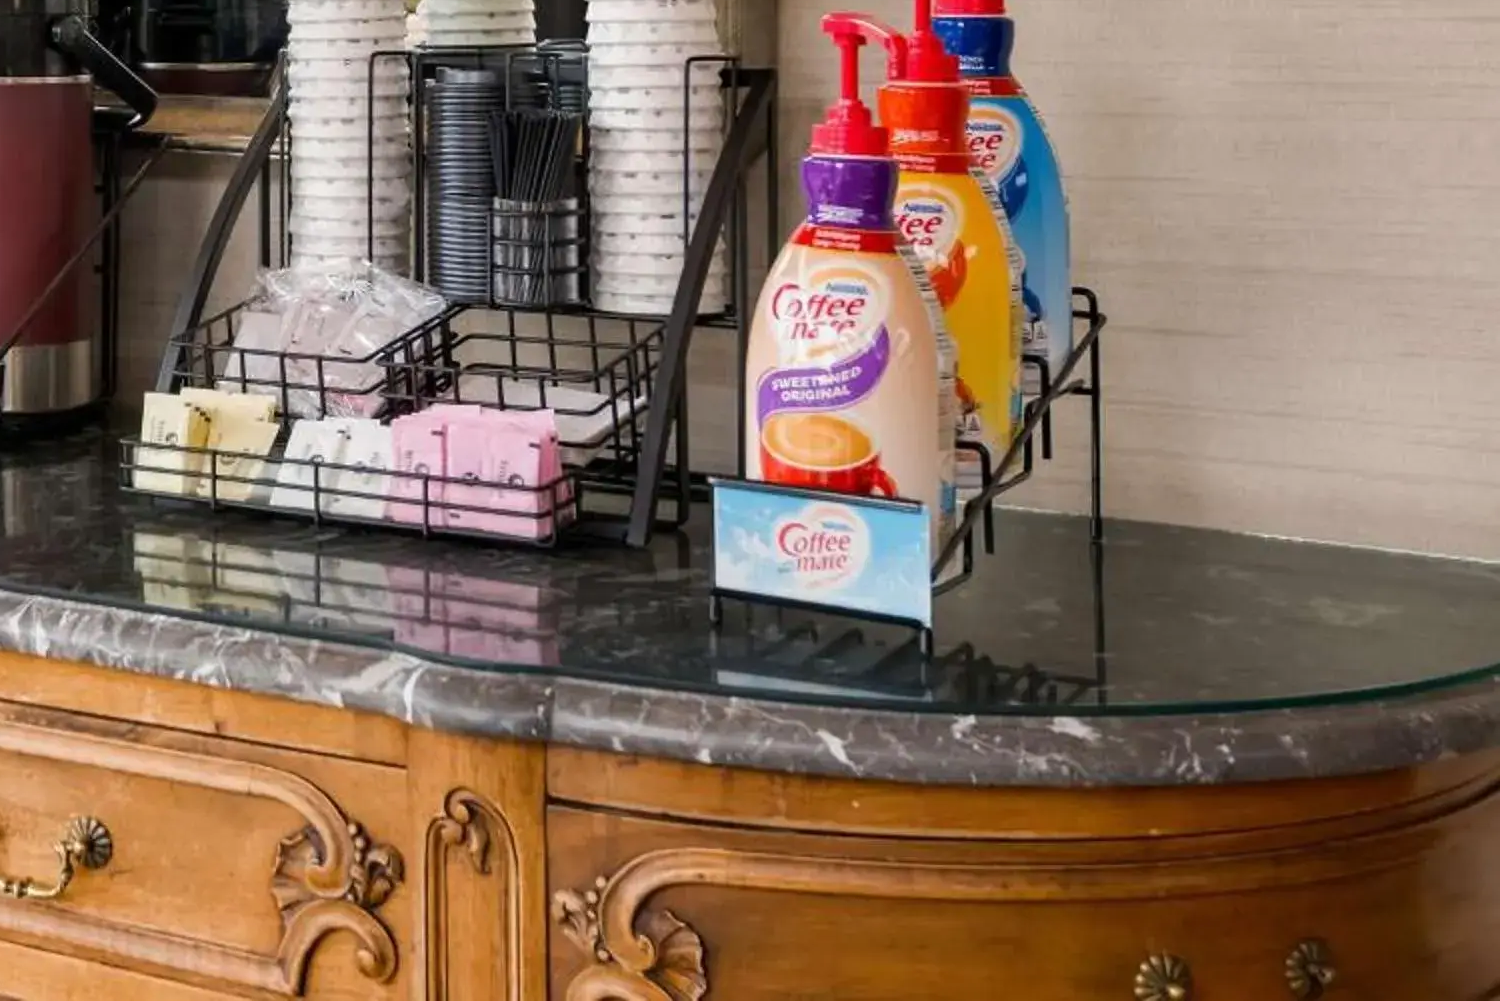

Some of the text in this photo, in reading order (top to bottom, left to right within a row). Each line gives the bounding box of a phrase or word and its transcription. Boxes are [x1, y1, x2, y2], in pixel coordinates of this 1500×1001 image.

[771, 365, 863, 392] SWEETENED
[780, 384, 851, 402] ORIGINAL
[777, 522, 852, 557] Coffee
